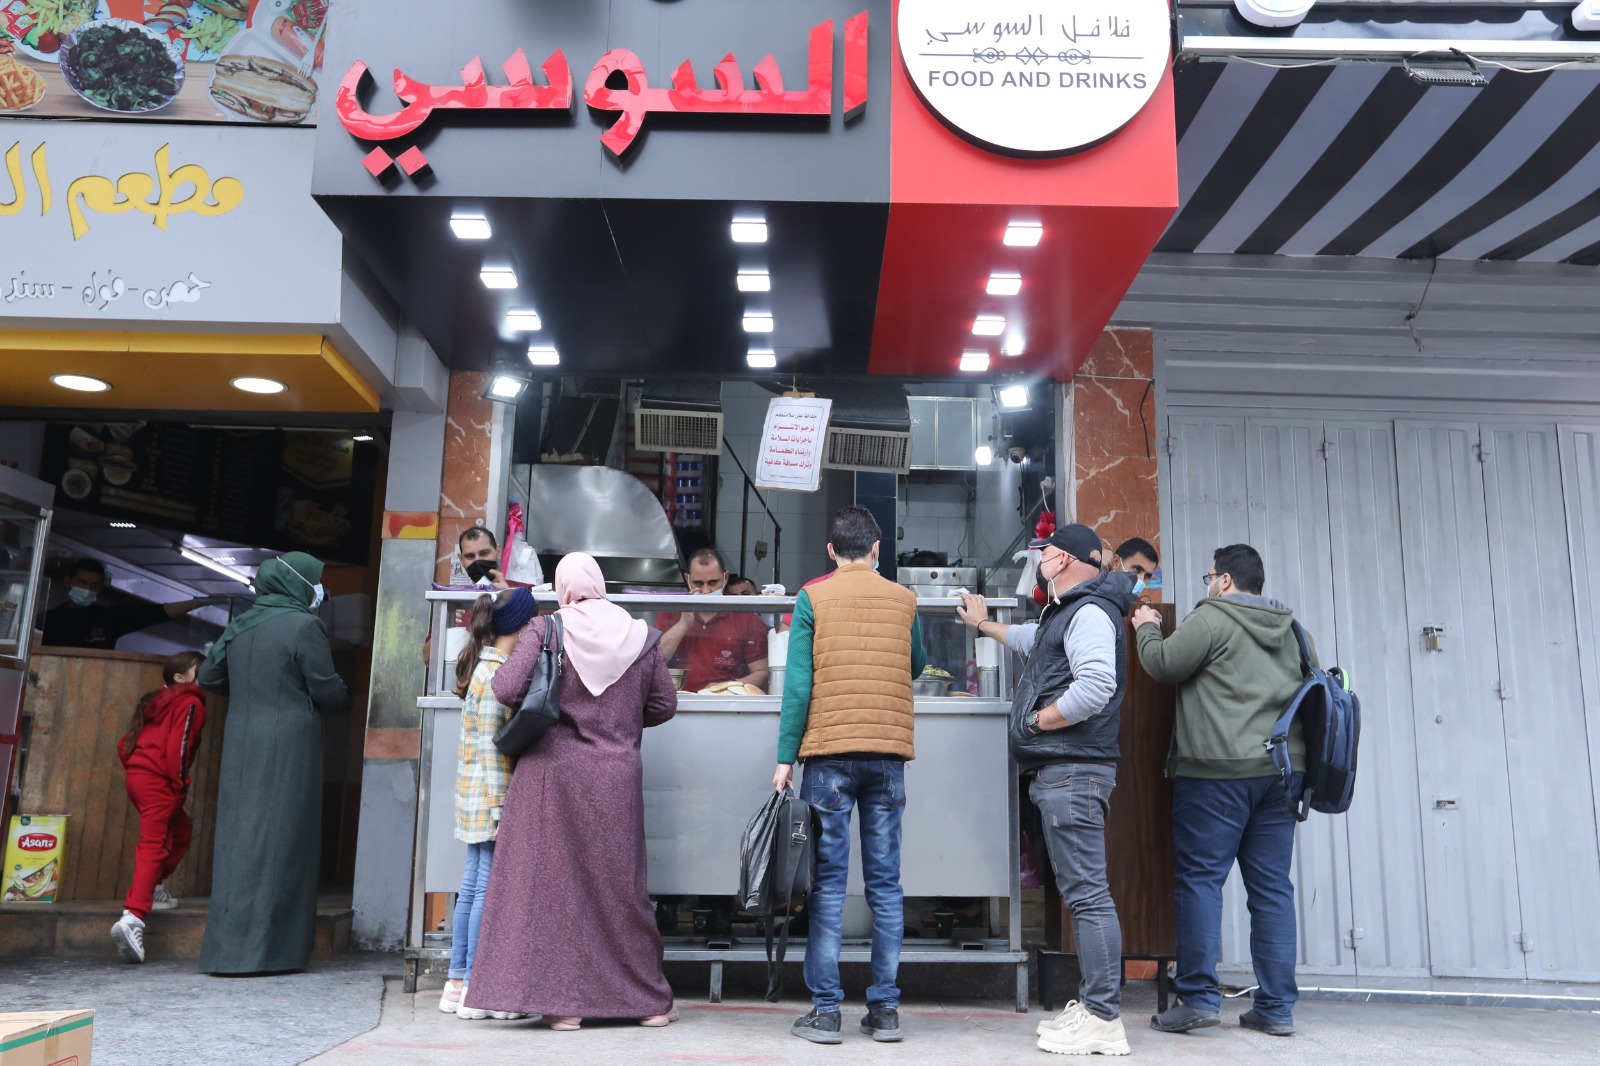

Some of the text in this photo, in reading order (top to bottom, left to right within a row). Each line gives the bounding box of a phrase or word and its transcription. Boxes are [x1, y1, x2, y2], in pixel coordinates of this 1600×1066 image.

[926, 14, 1130, 46] فلافل السوسي
[928, 70, 1147, 89] FOOD AND DRINKS
[336, 10, 869, 180] السوسي
[0, 141, 244, 241] مطعم ال
[0, 270, 55, 303] سند
[82, 269, 125, 311] فول
[142, 272, 212, 309] حمص
[770, 434, 790, 443] السلامة
[800, 424, 815, 433] نرجو
[764, 457, 782, 467] كافية
[769, 446, 795, 454] الكمامة
[22, 836, 49, 848] Asan
